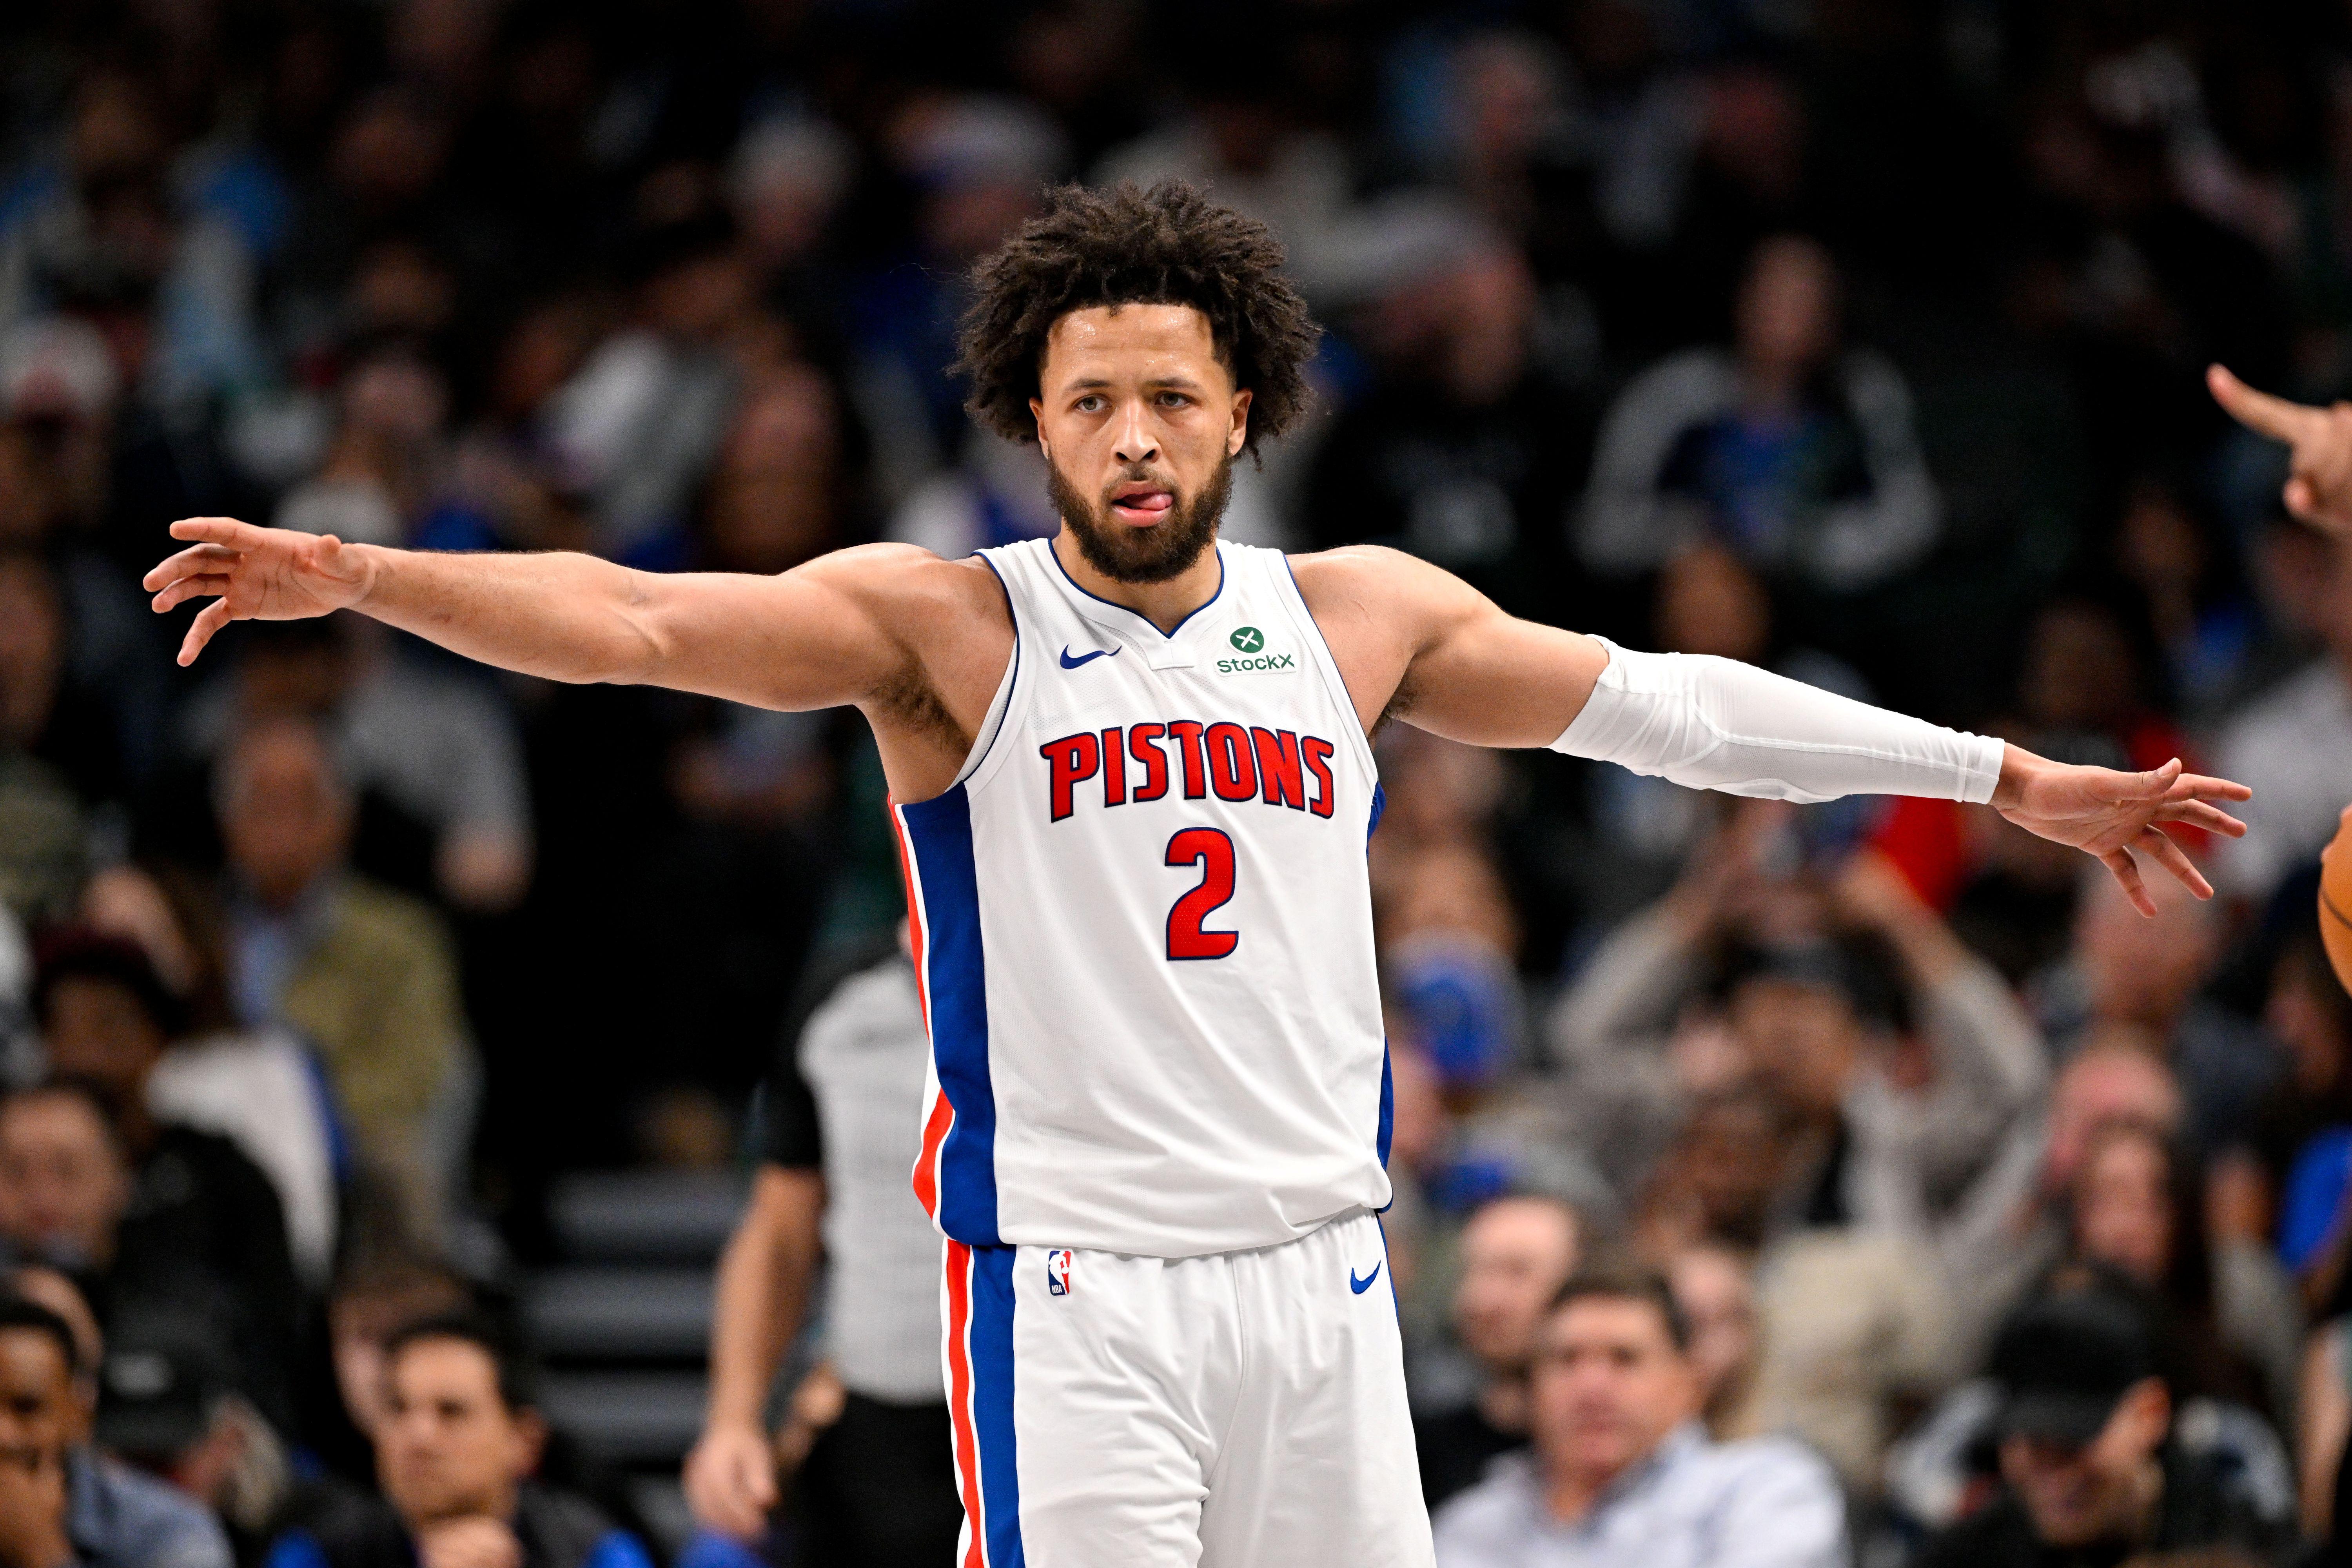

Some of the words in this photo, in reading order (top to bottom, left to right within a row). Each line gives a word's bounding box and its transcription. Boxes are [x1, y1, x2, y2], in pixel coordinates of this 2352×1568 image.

[1040, 720, 1334, 823] PISTONS
[1165, 827, 1239, 961] 2
[1051, 1285, 1063, 1294] NBA
